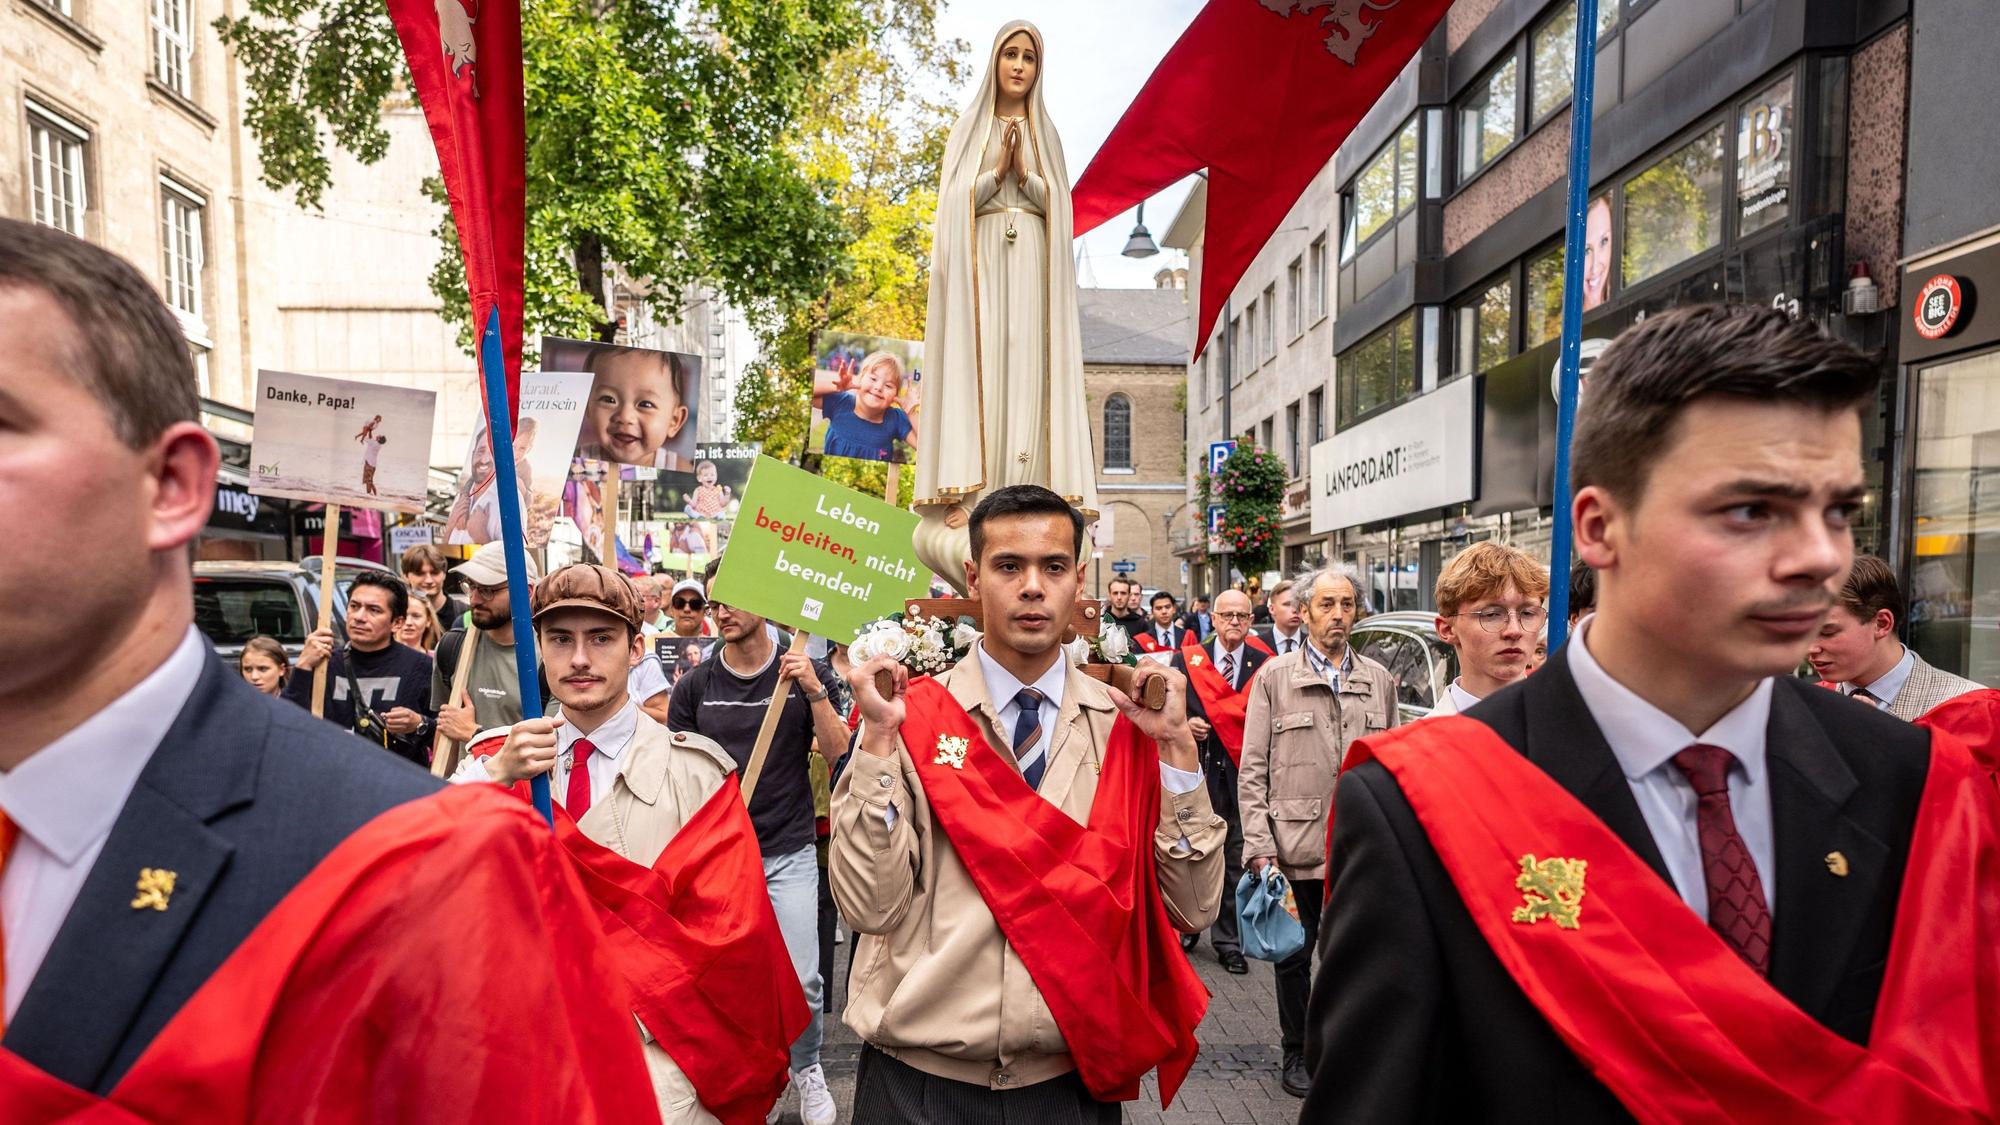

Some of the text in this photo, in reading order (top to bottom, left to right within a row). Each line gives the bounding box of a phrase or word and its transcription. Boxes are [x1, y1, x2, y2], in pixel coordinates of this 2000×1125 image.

[1929, 294, 1945, 307] SEE
[267, 386, 355, 410] Danke, Papa!
[535, 400, 550, 410] zu
[551, 398, 577, 411] sein
[695, 446, 757, 459] en ist schön!
[1213, 446, 1229, 473] P
[218, 489, 259, 522] mey
[815, 494, 880, 535] Leben
[395, 529, 427, 538] OSCAR
[755, 506, 917, 582] begleiten, nicht
[774, 550, 873, 601] beenden!
